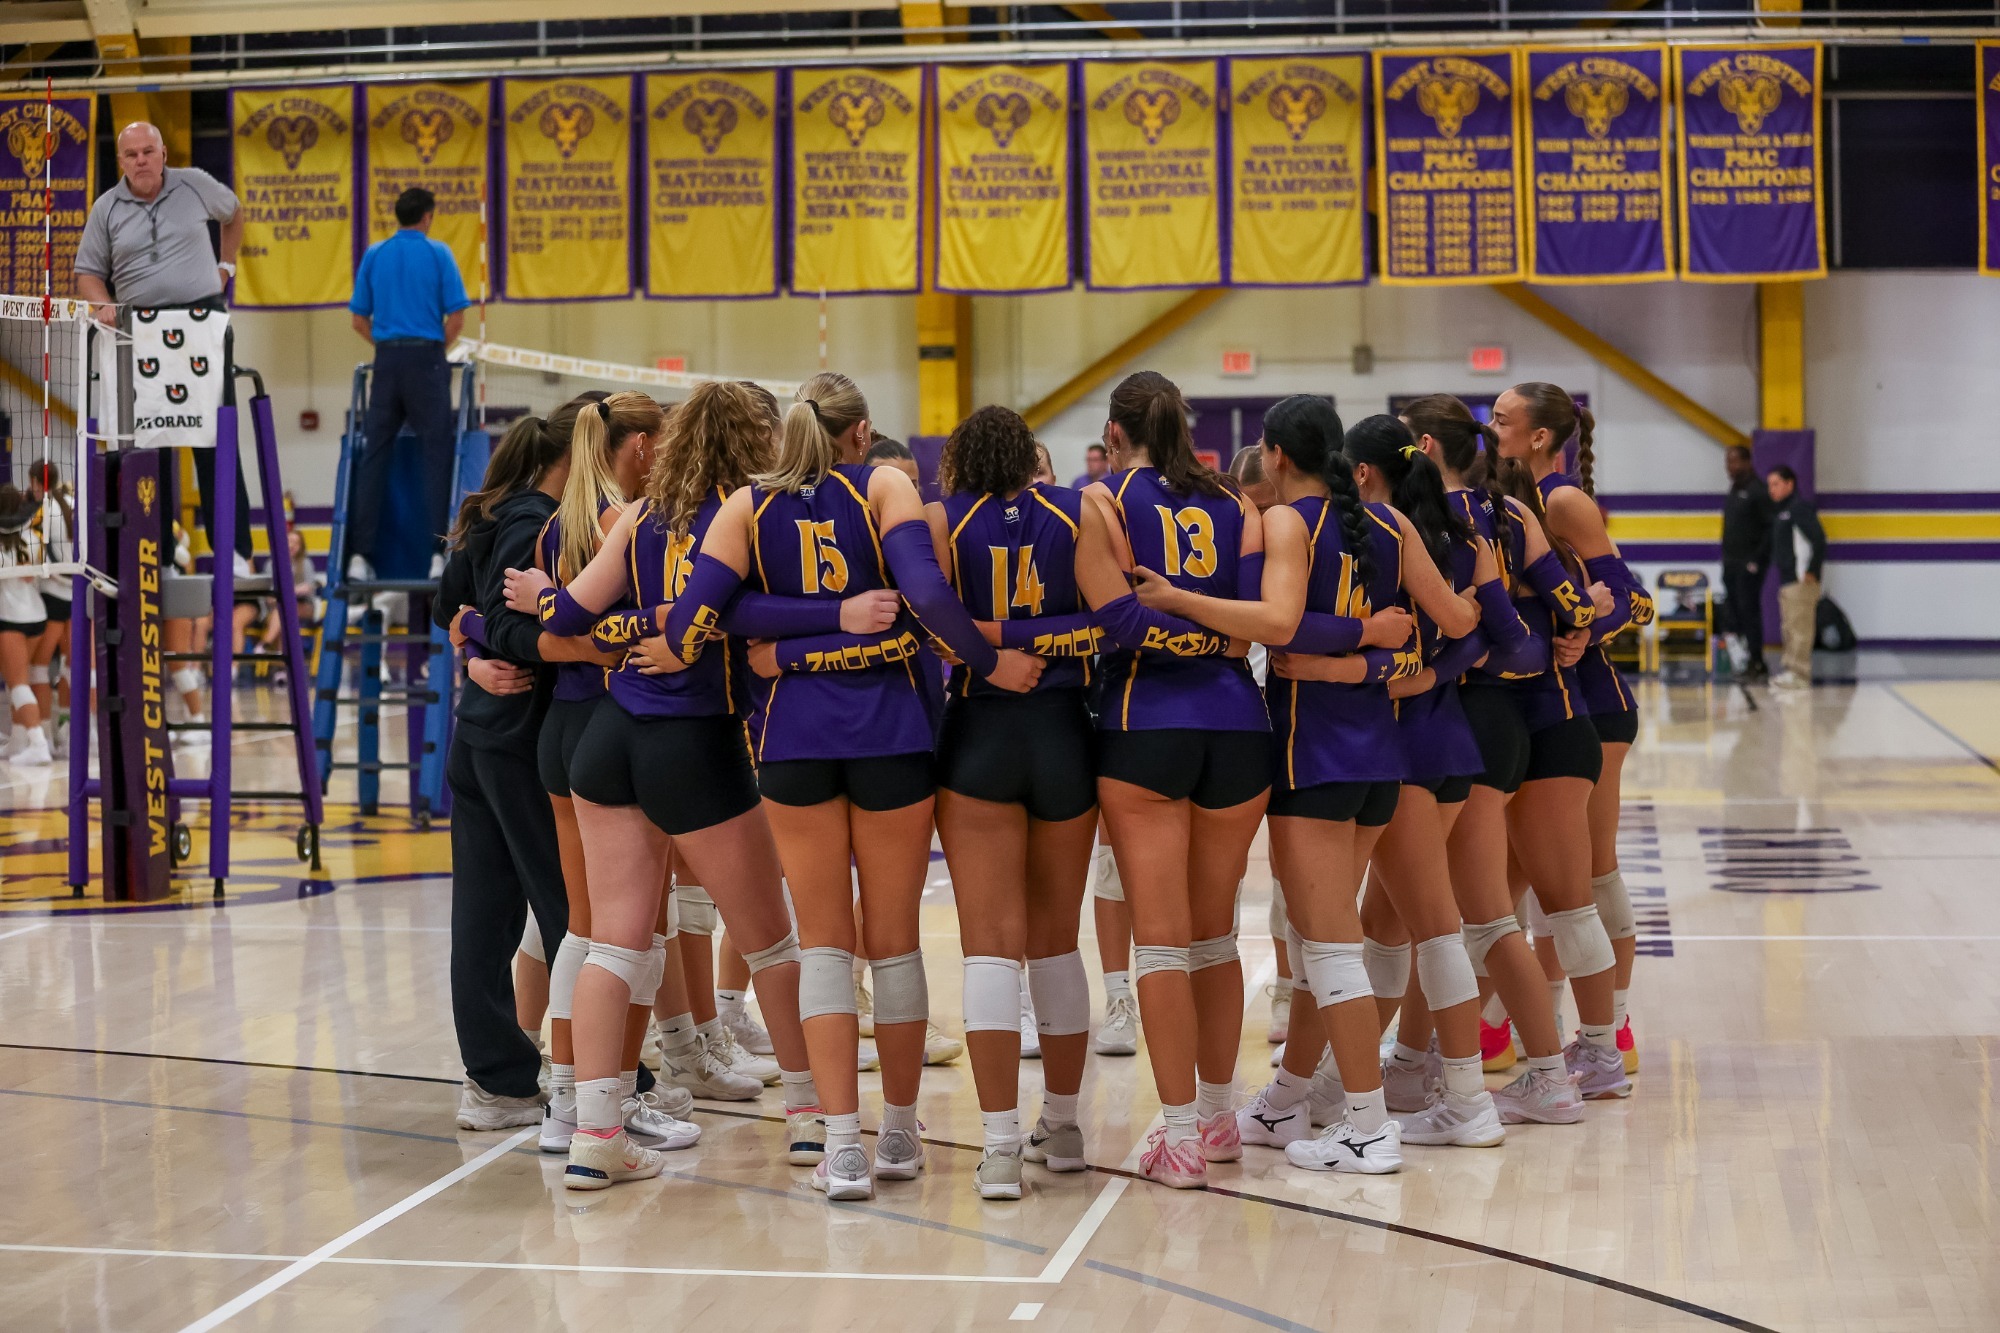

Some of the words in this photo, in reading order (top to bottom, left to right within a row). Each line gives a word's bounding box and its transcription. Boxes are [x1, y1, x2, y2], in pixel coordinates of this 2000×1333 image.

[1389, 170, 1512, 191] CHAMPIONS
[1537, 171, 1660, 192] CHAMPIONS
[1690, 167, 1813, 188] CHAMPIONS
[2, 300, 24, 317] WEST
[135, 415, 203, 429] ATORADE
[794, 519, 848, 594] 15
[1154, 505, 1217, 578] 13
[988, 544, 1044, 620] 14
[138, 537, 162, 729] CHESTER
[591, 614, 641, 644] AMS
[1140, 626, 1219, 656] RAMS
[144, 736, 168, 858] WEST
